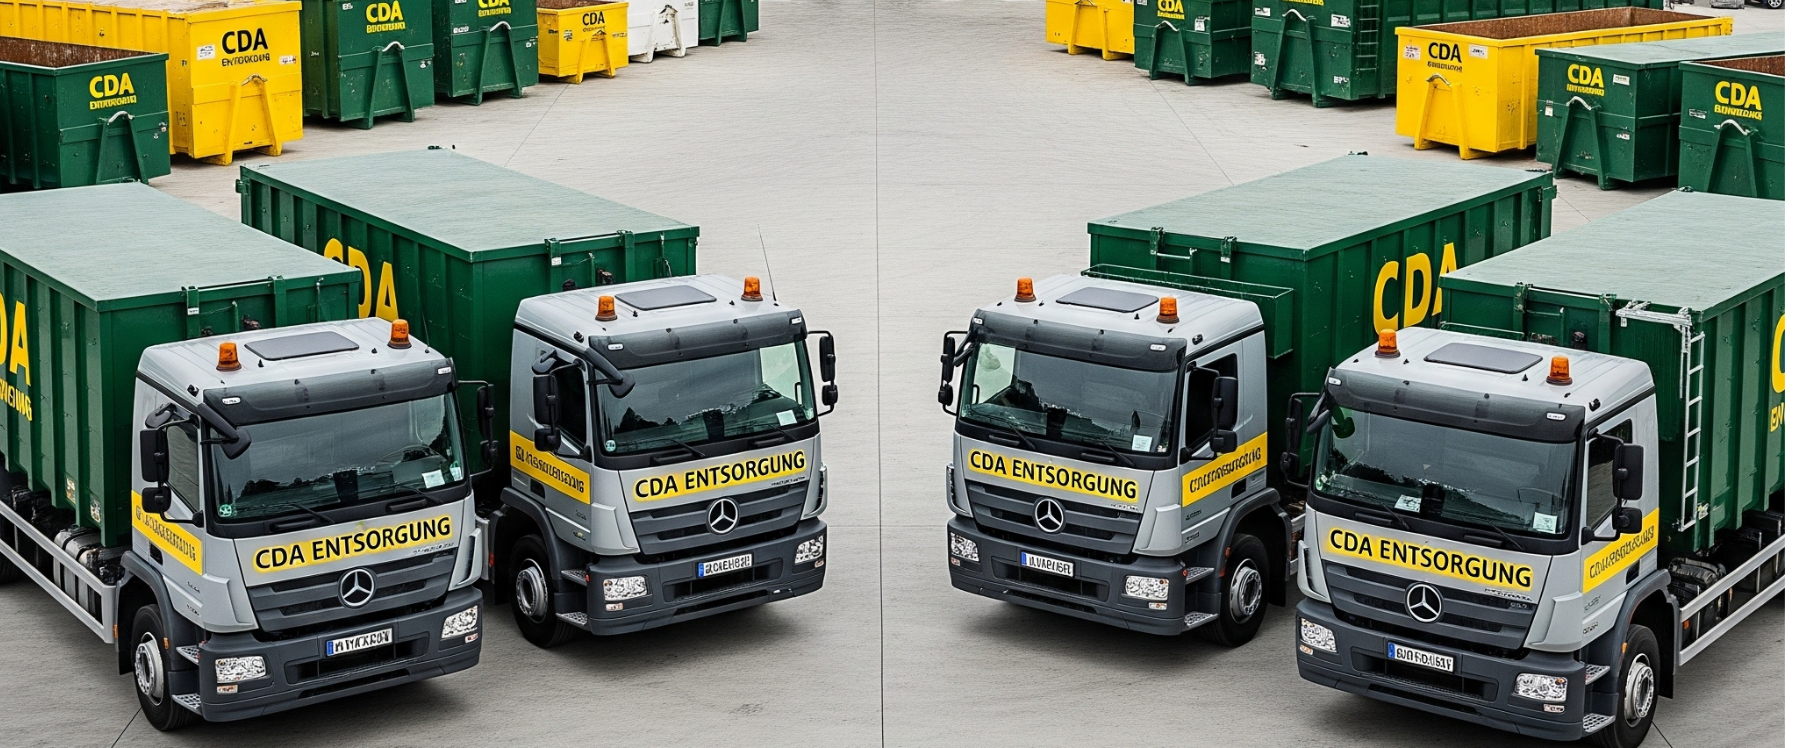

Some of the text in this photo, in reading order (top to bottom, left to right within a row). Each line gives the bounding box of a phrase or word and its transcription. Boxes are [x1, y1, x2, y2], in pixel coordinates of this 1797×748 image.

[366, 1, 404, 23] CDA
[582, 10, 605, 26] CDA
[222, 28, 268, 55] CDA
[1428, 42, 1462, 63] CDA
[89, 72, 135, 98] CDA
[1567, 64, 1605, 88] CDA
[1715, 81, 1762, 110] CDA
[635, 450, 805, 498] CDA ENTSORGUNG
[970, 450, 1137, 500] CDA ENTSORGUNG
[255, 544, 305, 570] CDA
[312, 516, 451, 561] ENTSORGUNG
[1330, 529, 1532, 588] CDA ENTSORGUNG
